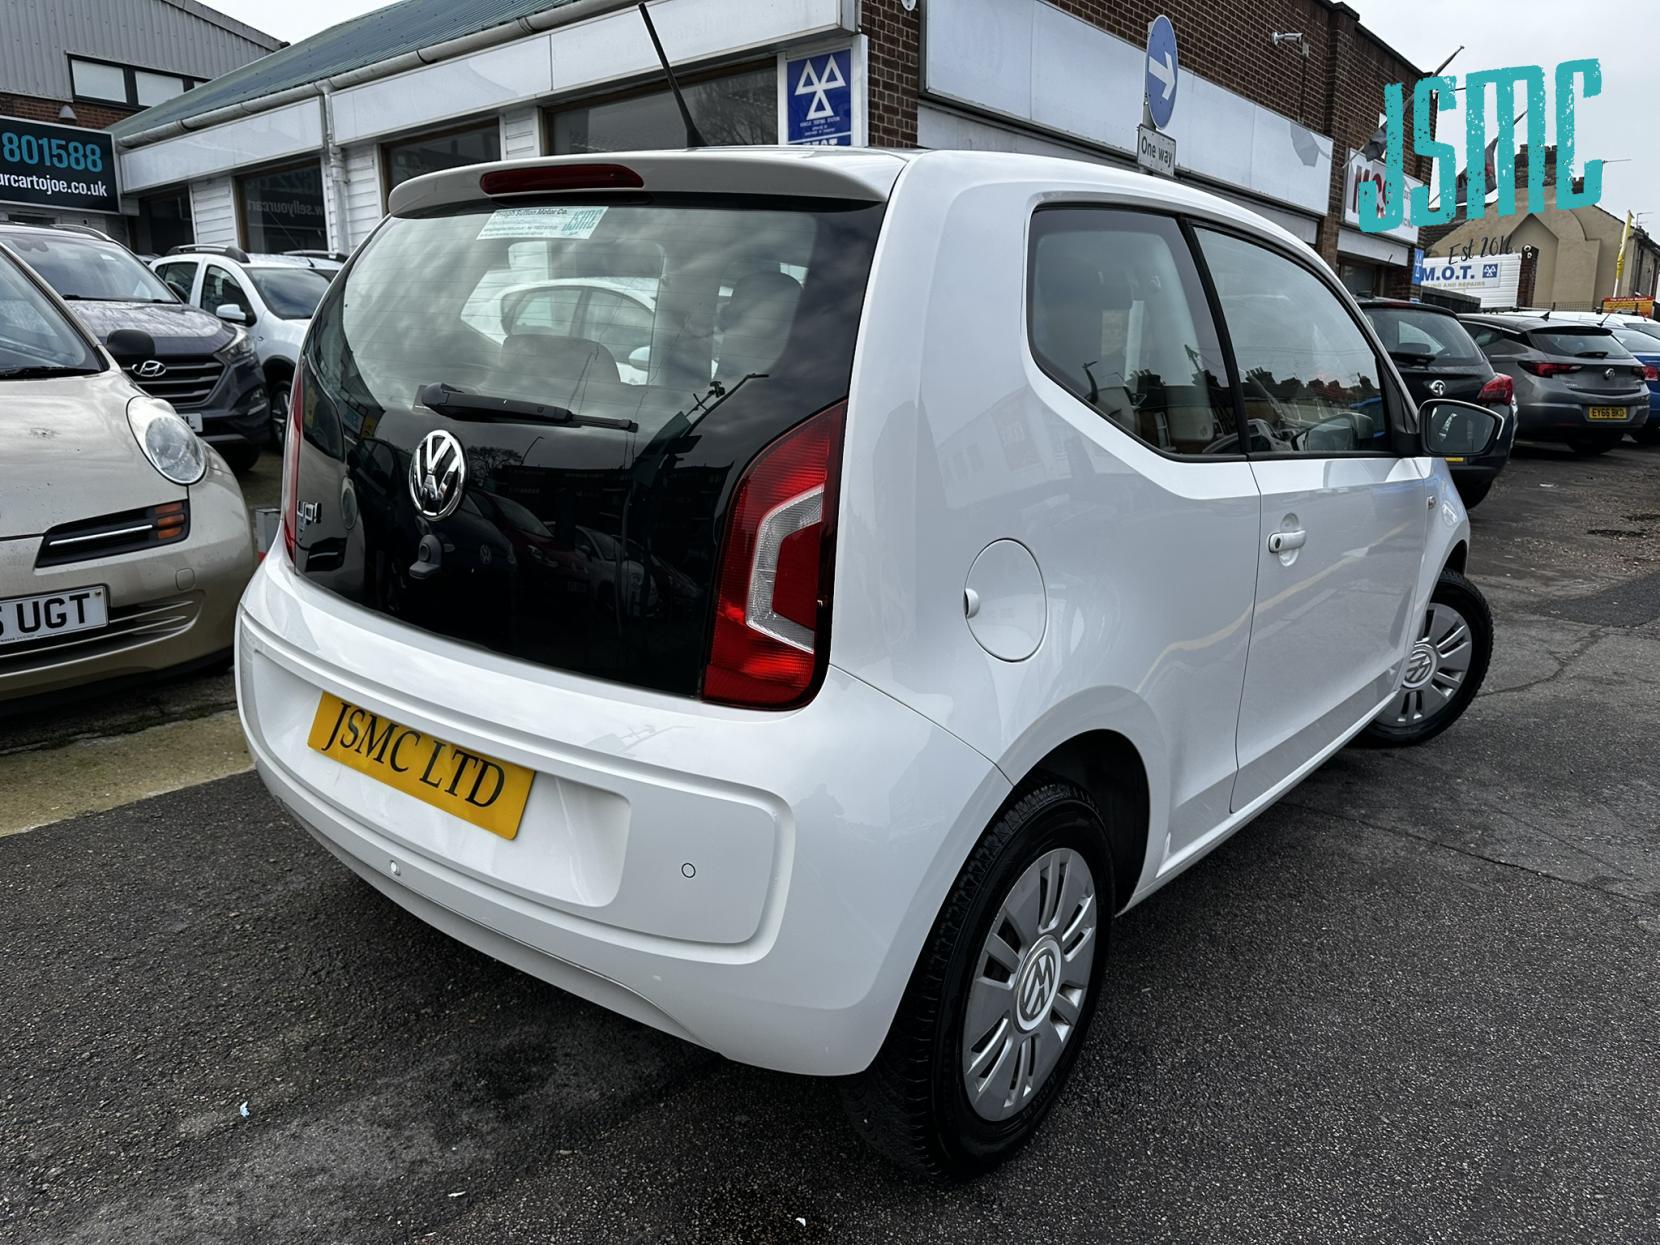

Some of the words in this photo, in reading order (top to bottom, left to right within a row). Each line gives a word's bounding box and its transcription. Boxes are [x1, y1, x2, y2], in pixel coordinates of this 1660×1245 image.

[1, 131, 103, 172] 801588
[1141, 136, 1157, 158] One
[1158, 147, 1173, 168] way
[1423, 265, 1475, 281] M.O.T.
[16, 592, 90, 634] UGT
[321, 702, 421, 773] JSMC
[419, 740, 505, 808] LTD
